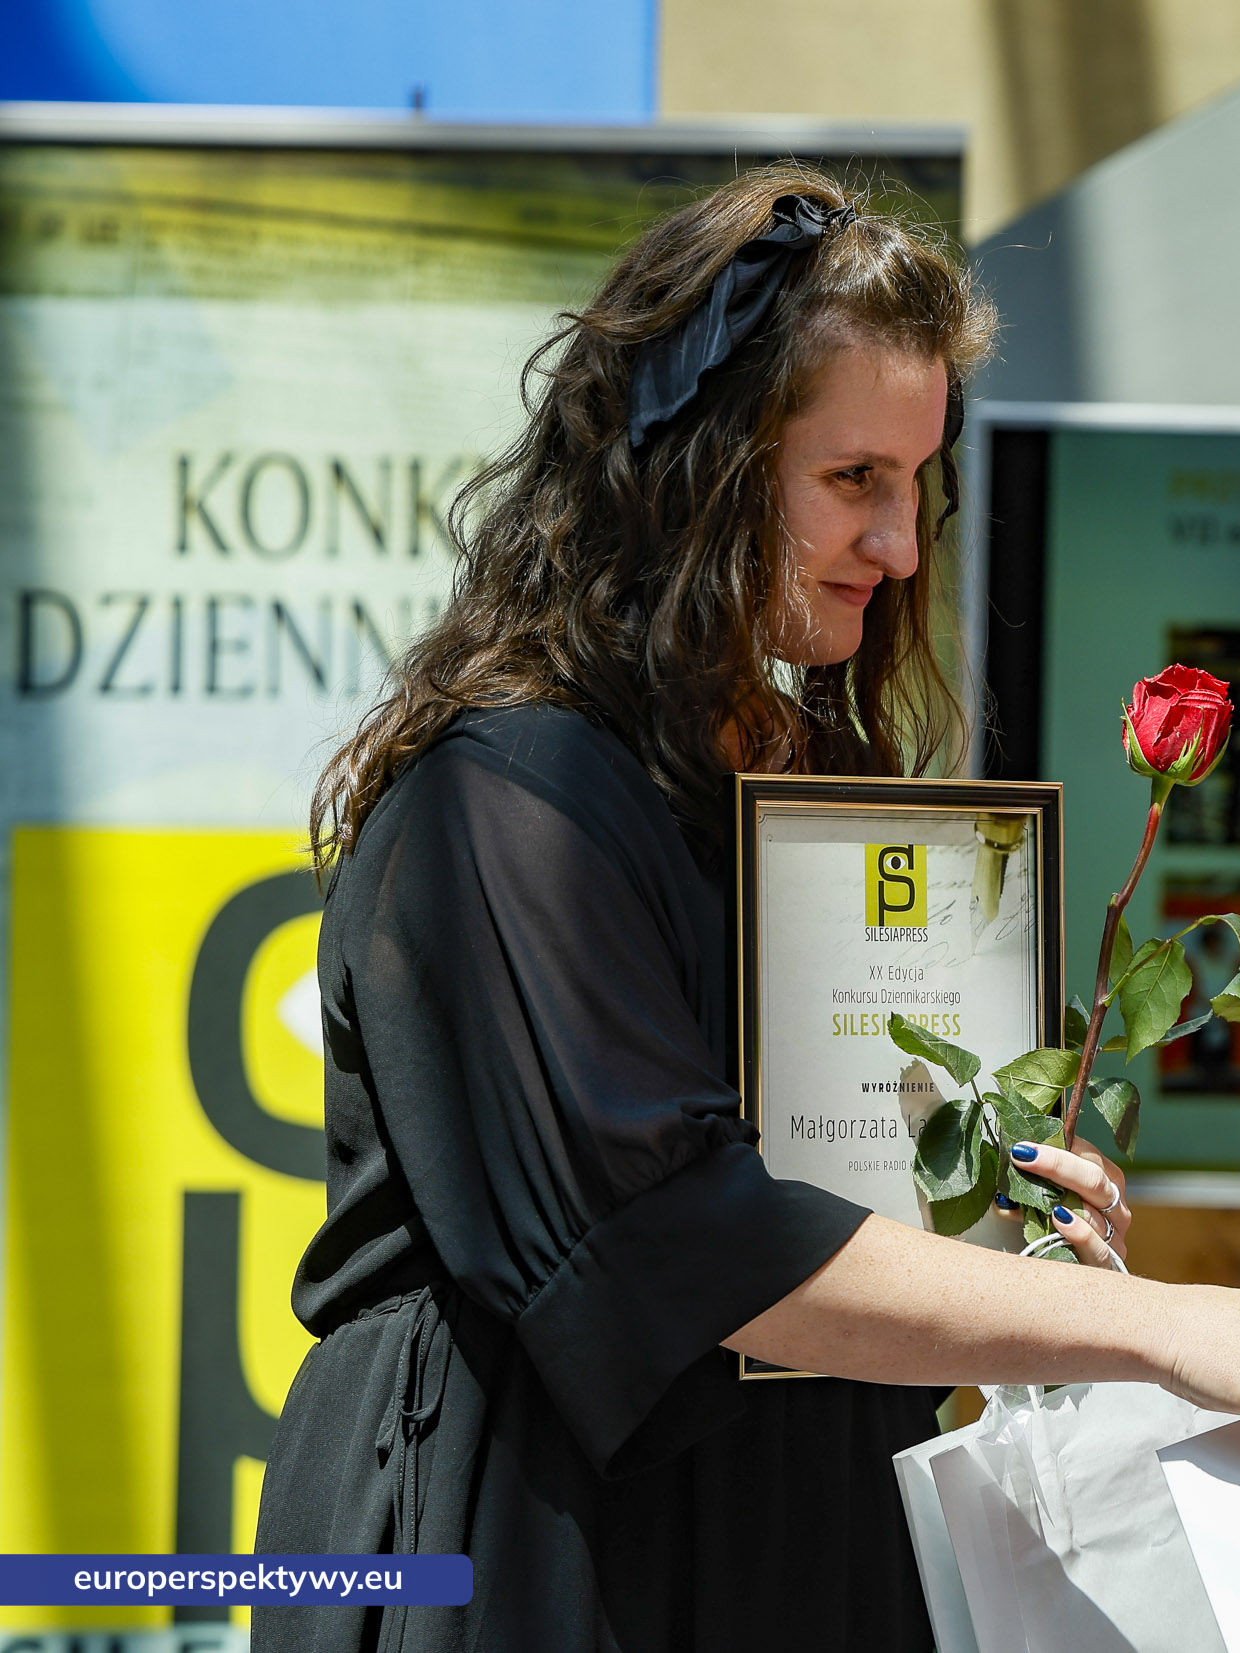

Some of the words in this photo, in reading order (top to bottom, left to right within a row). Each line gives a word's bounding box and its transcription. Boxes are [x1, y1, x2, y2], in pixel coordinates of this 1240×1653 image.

[172, 453, 466, 560] KONK
[14, 588, 420, 699] DZIENN
[865, 927, 928, 942] SILESIAPRESS
[869, 965, 883, 980] XX
[888, 965, 924, 982] Edycja
[832, 988, 878, 1004] Konkursu
[881, 988, 961, 1006] Dziennikarskiego
[861, 1080, 935, 1093] WYRÓŻNIENIE
[790, 1114, 898, 1143] Małgorzata
[848, 1160, 880, 1171] POLSKIE
[883, 1159, 907, 1171] RADIO
